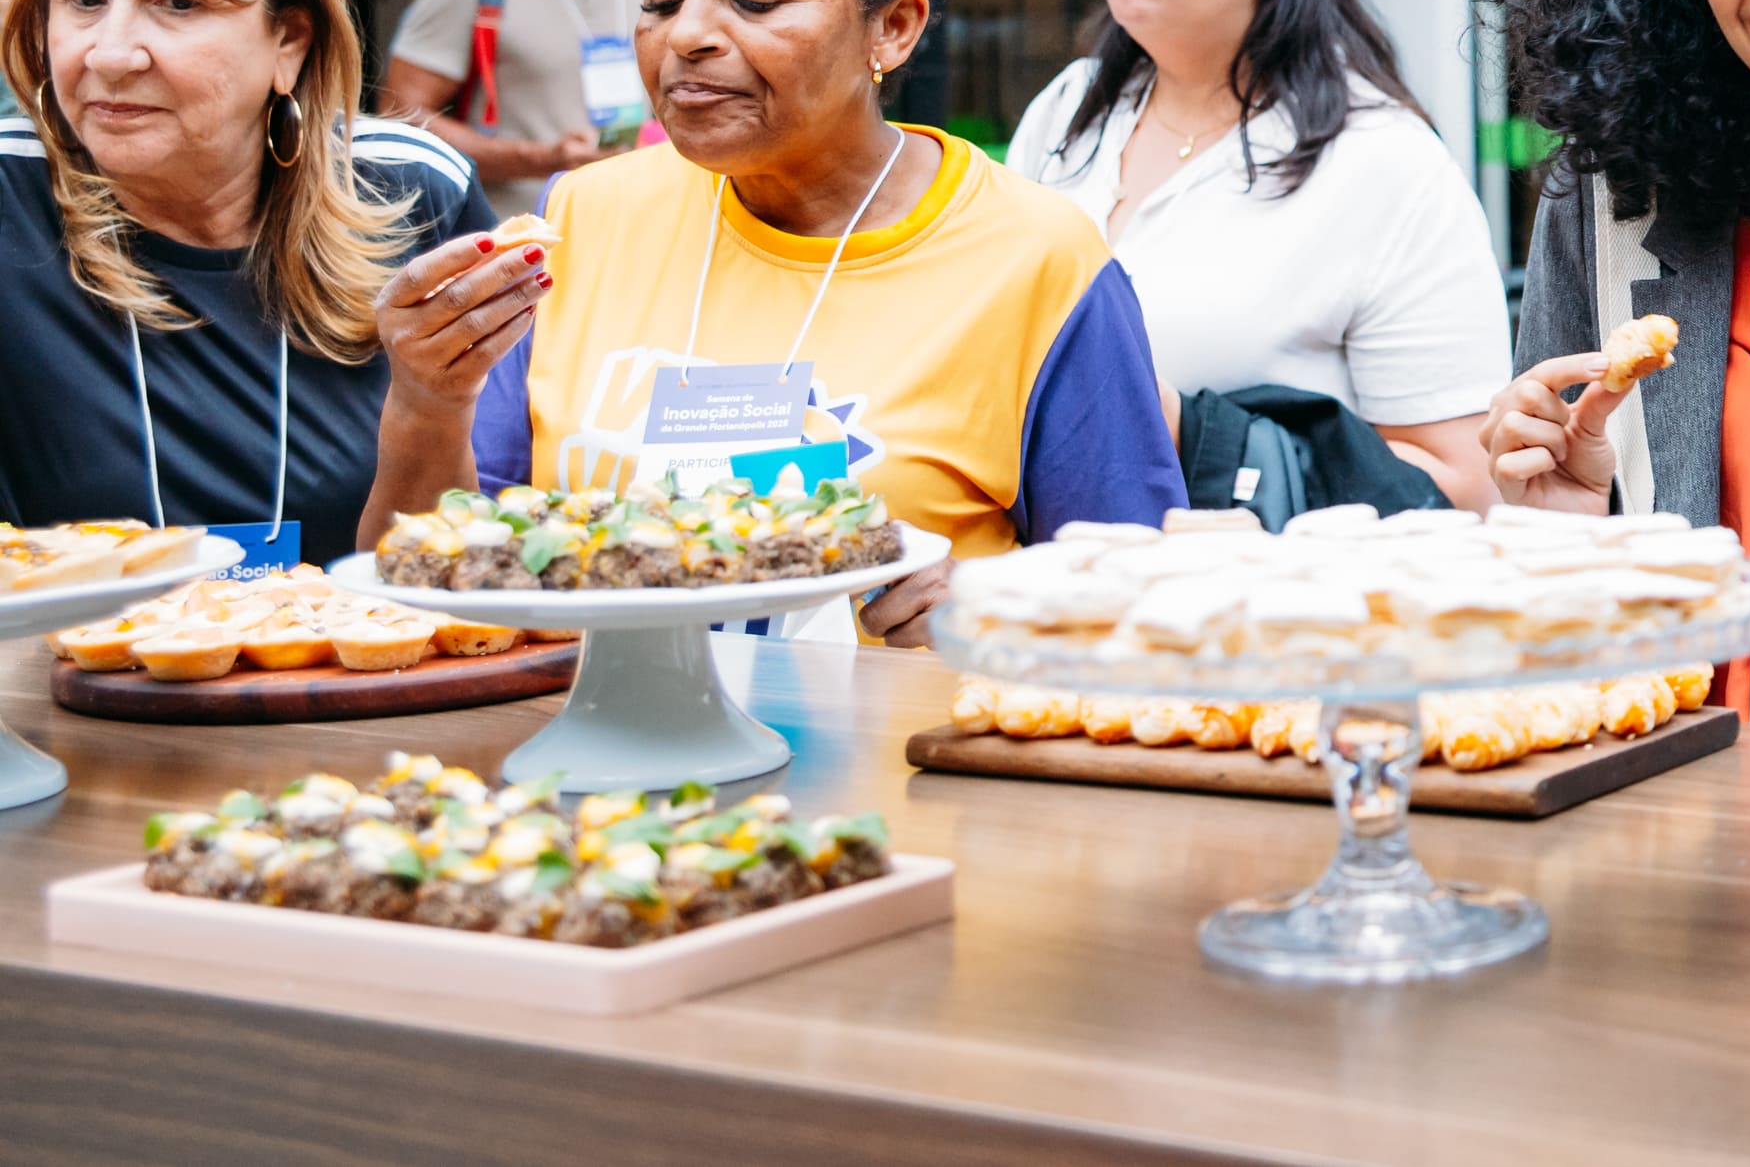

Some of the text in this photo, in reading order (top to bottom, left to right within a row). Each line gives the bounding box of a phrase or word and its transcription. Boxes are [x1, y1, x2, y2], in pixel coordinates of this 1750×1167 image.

[663, 401, 793, 422] Inovação Social
[668, 457, 730, 469] PARTICIP
